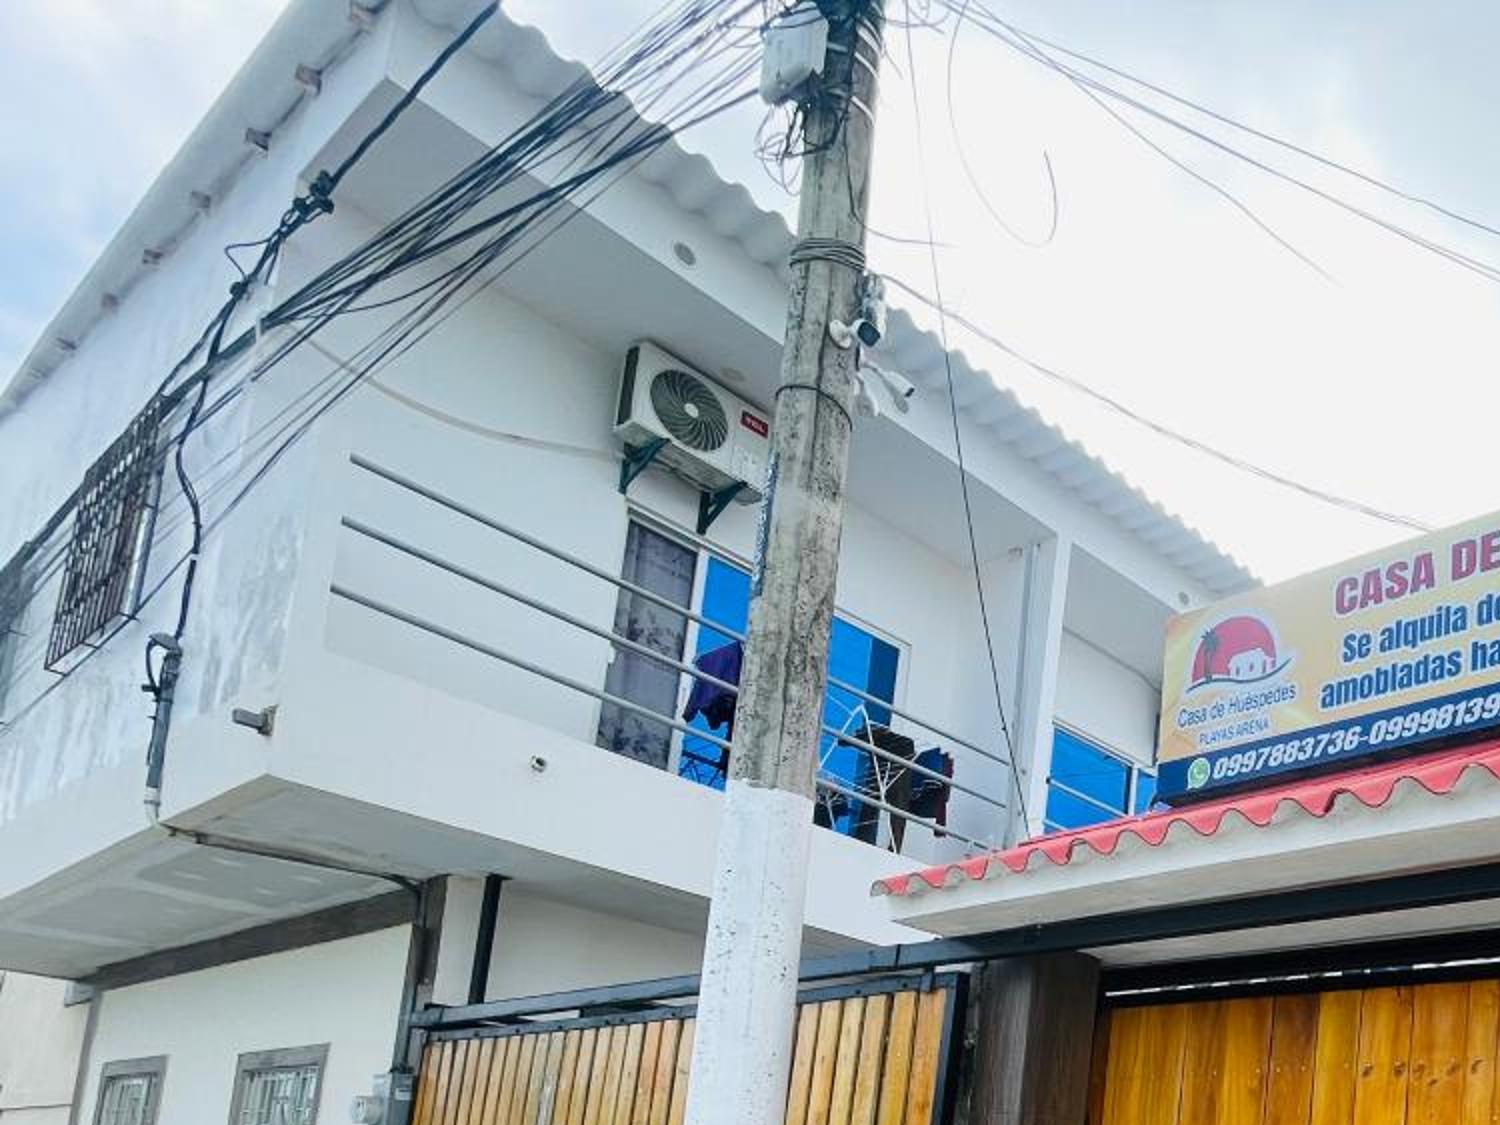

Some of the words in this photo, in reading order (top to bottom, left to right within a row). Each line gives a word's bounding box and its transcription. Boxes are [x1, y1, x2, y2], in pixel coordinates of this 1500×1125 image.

[1335, 551, 1435, 615] CASA
[1379, 604, 1467, 654] alquila
[1320, 650, 1462, 708] amobladas
